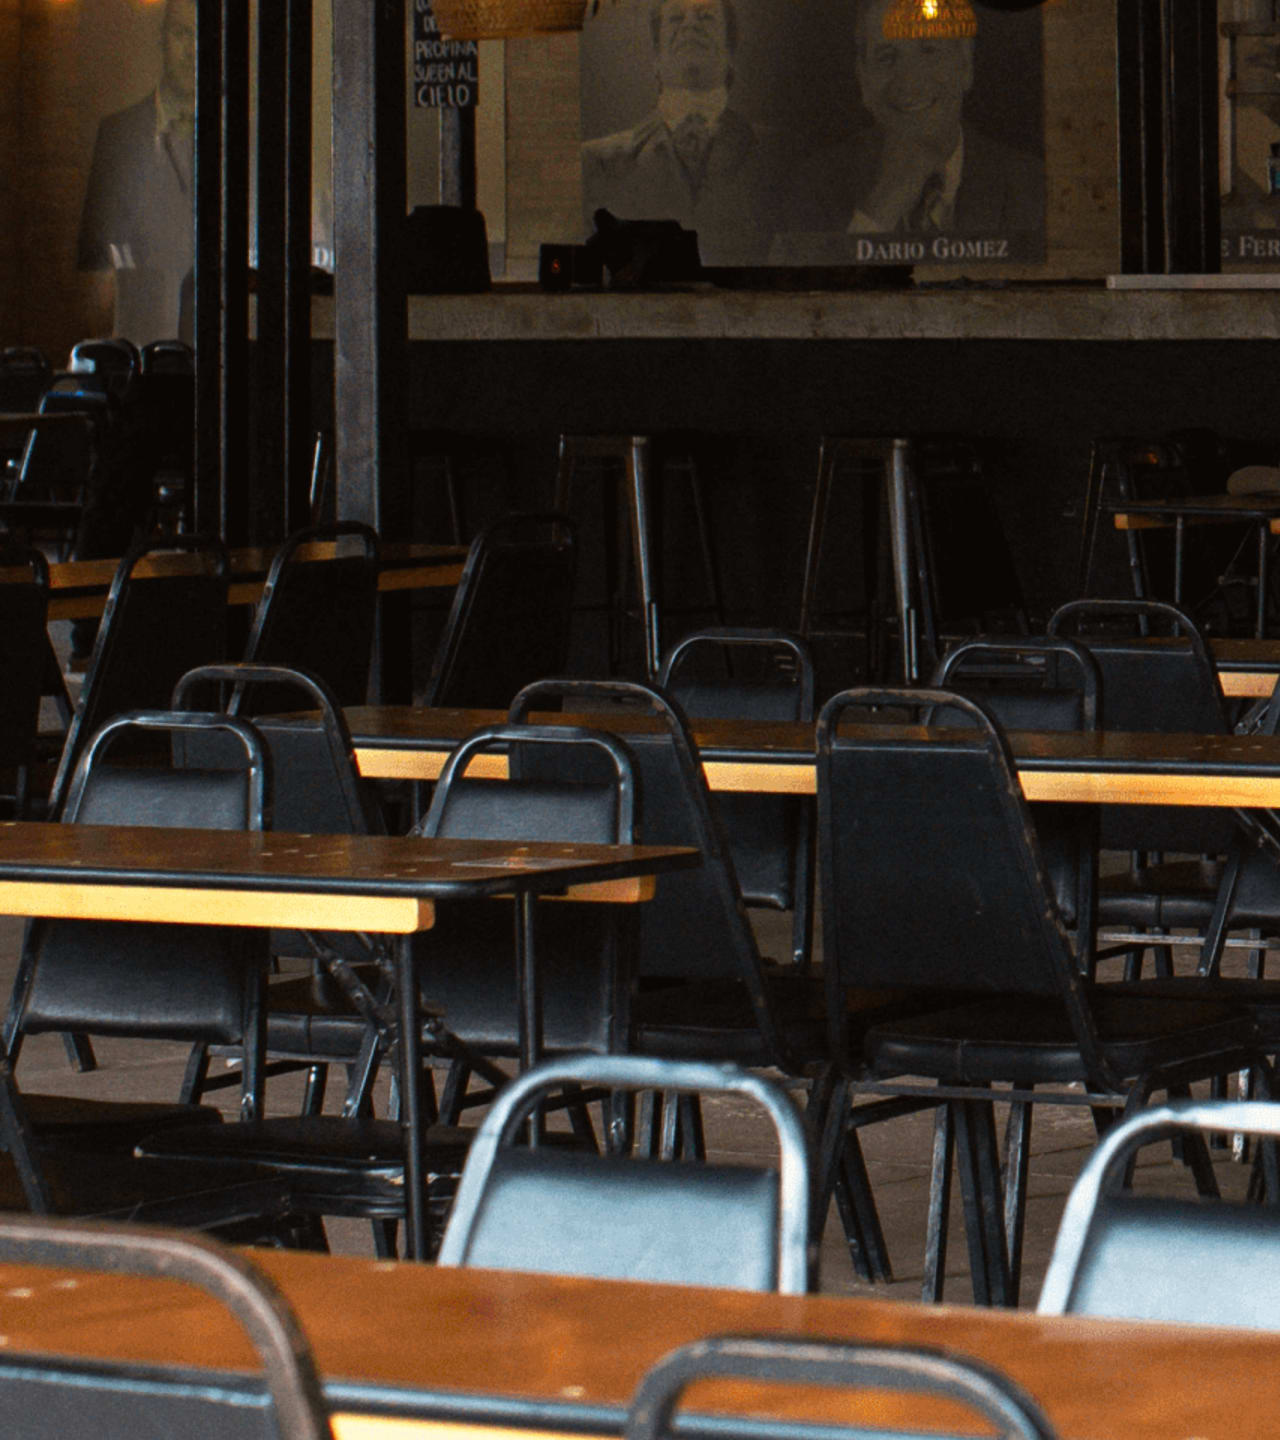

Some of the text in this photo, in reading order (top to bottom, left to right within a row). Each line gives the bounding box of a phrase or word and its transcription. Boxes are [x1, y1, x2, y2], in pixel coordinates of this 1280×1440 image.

[457, 61, 478, 81] AL
[417, 83, 470, 108] CIELO
[856, 237, 1009, 261] DARIO GOMEZ
